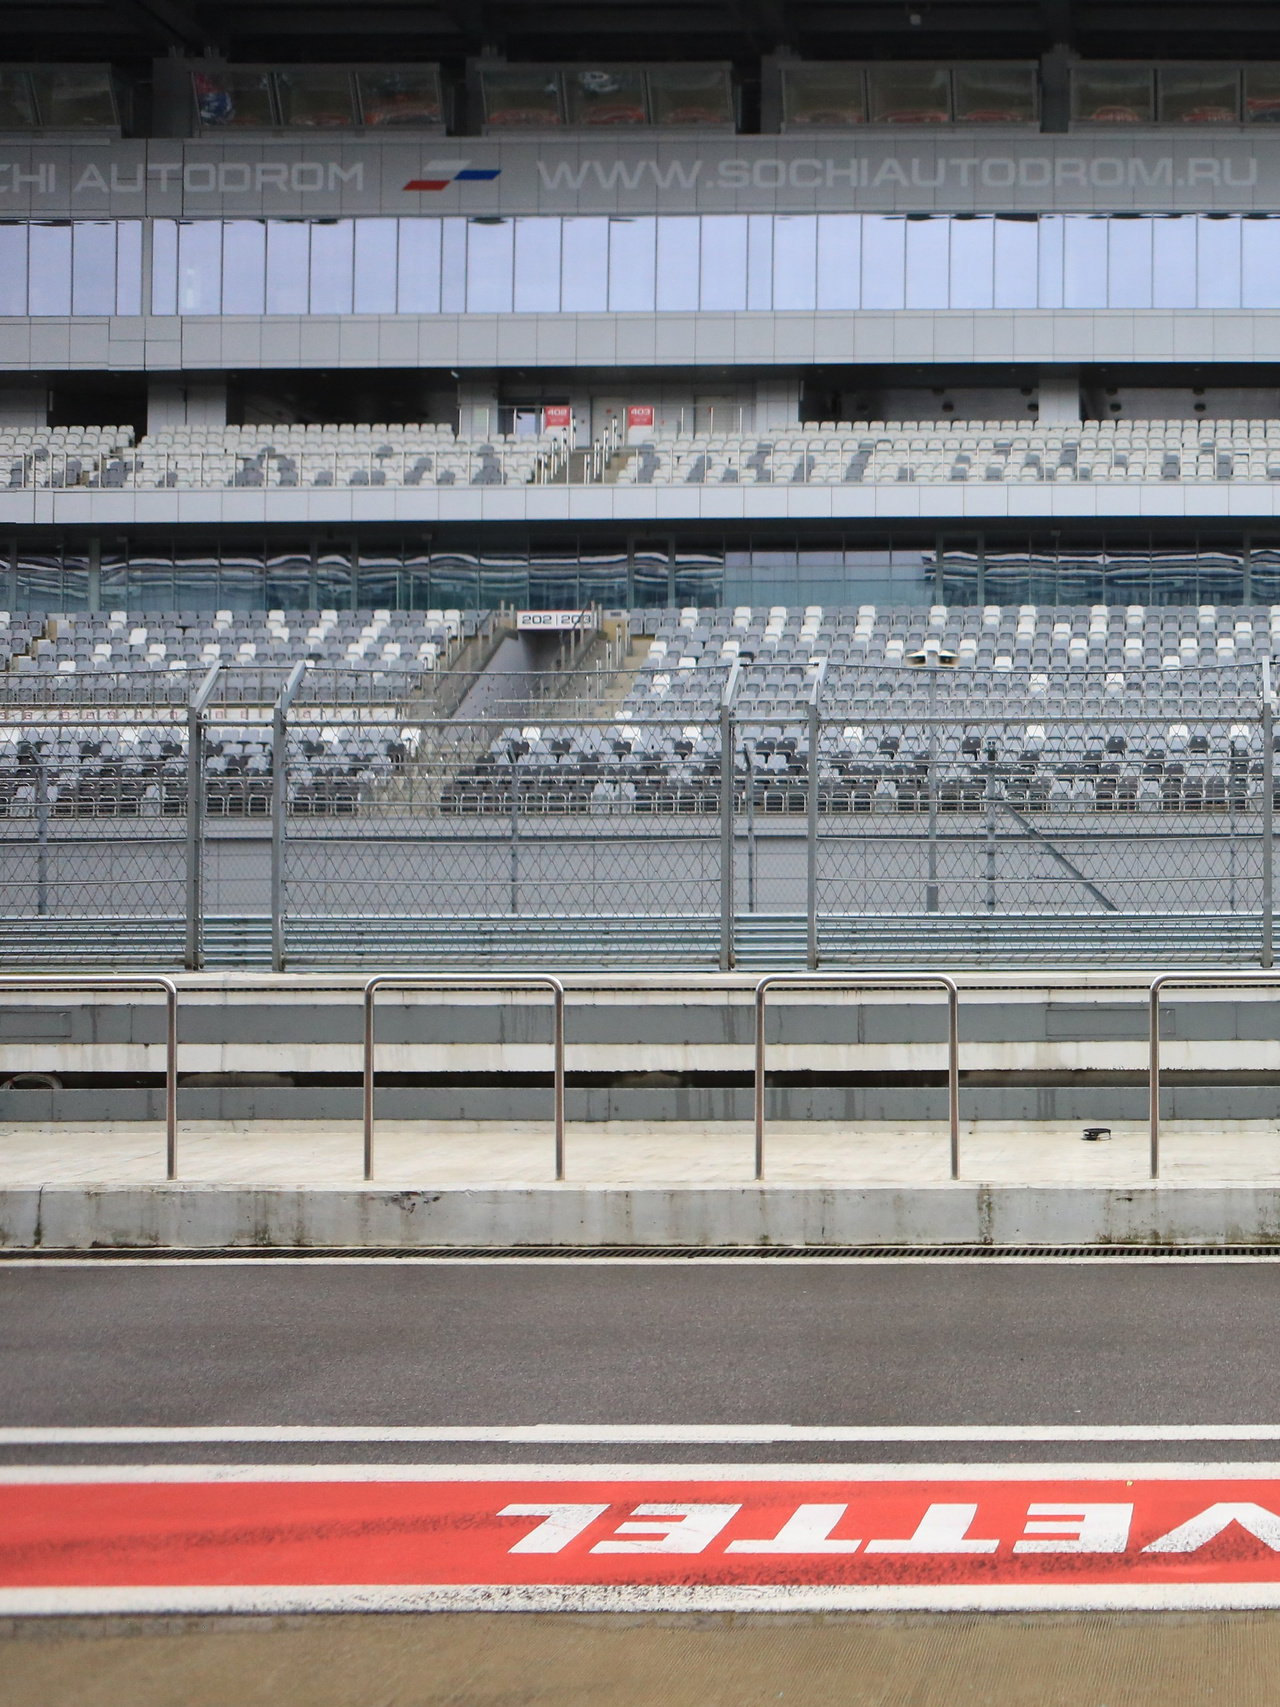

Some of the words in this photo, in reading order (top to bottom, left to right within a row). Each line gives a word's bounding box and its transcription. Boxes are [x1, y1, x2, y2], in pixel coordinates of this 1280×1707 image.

[72, 162, 364, 193] AUTODROM
[536, 157, 1258, 190] WWW.SOCHIAUTODROM.RU
[630, 407, 650, 416] 403
[522, 614, 552, 624] 202
[561, 614, 591, 624] 203
